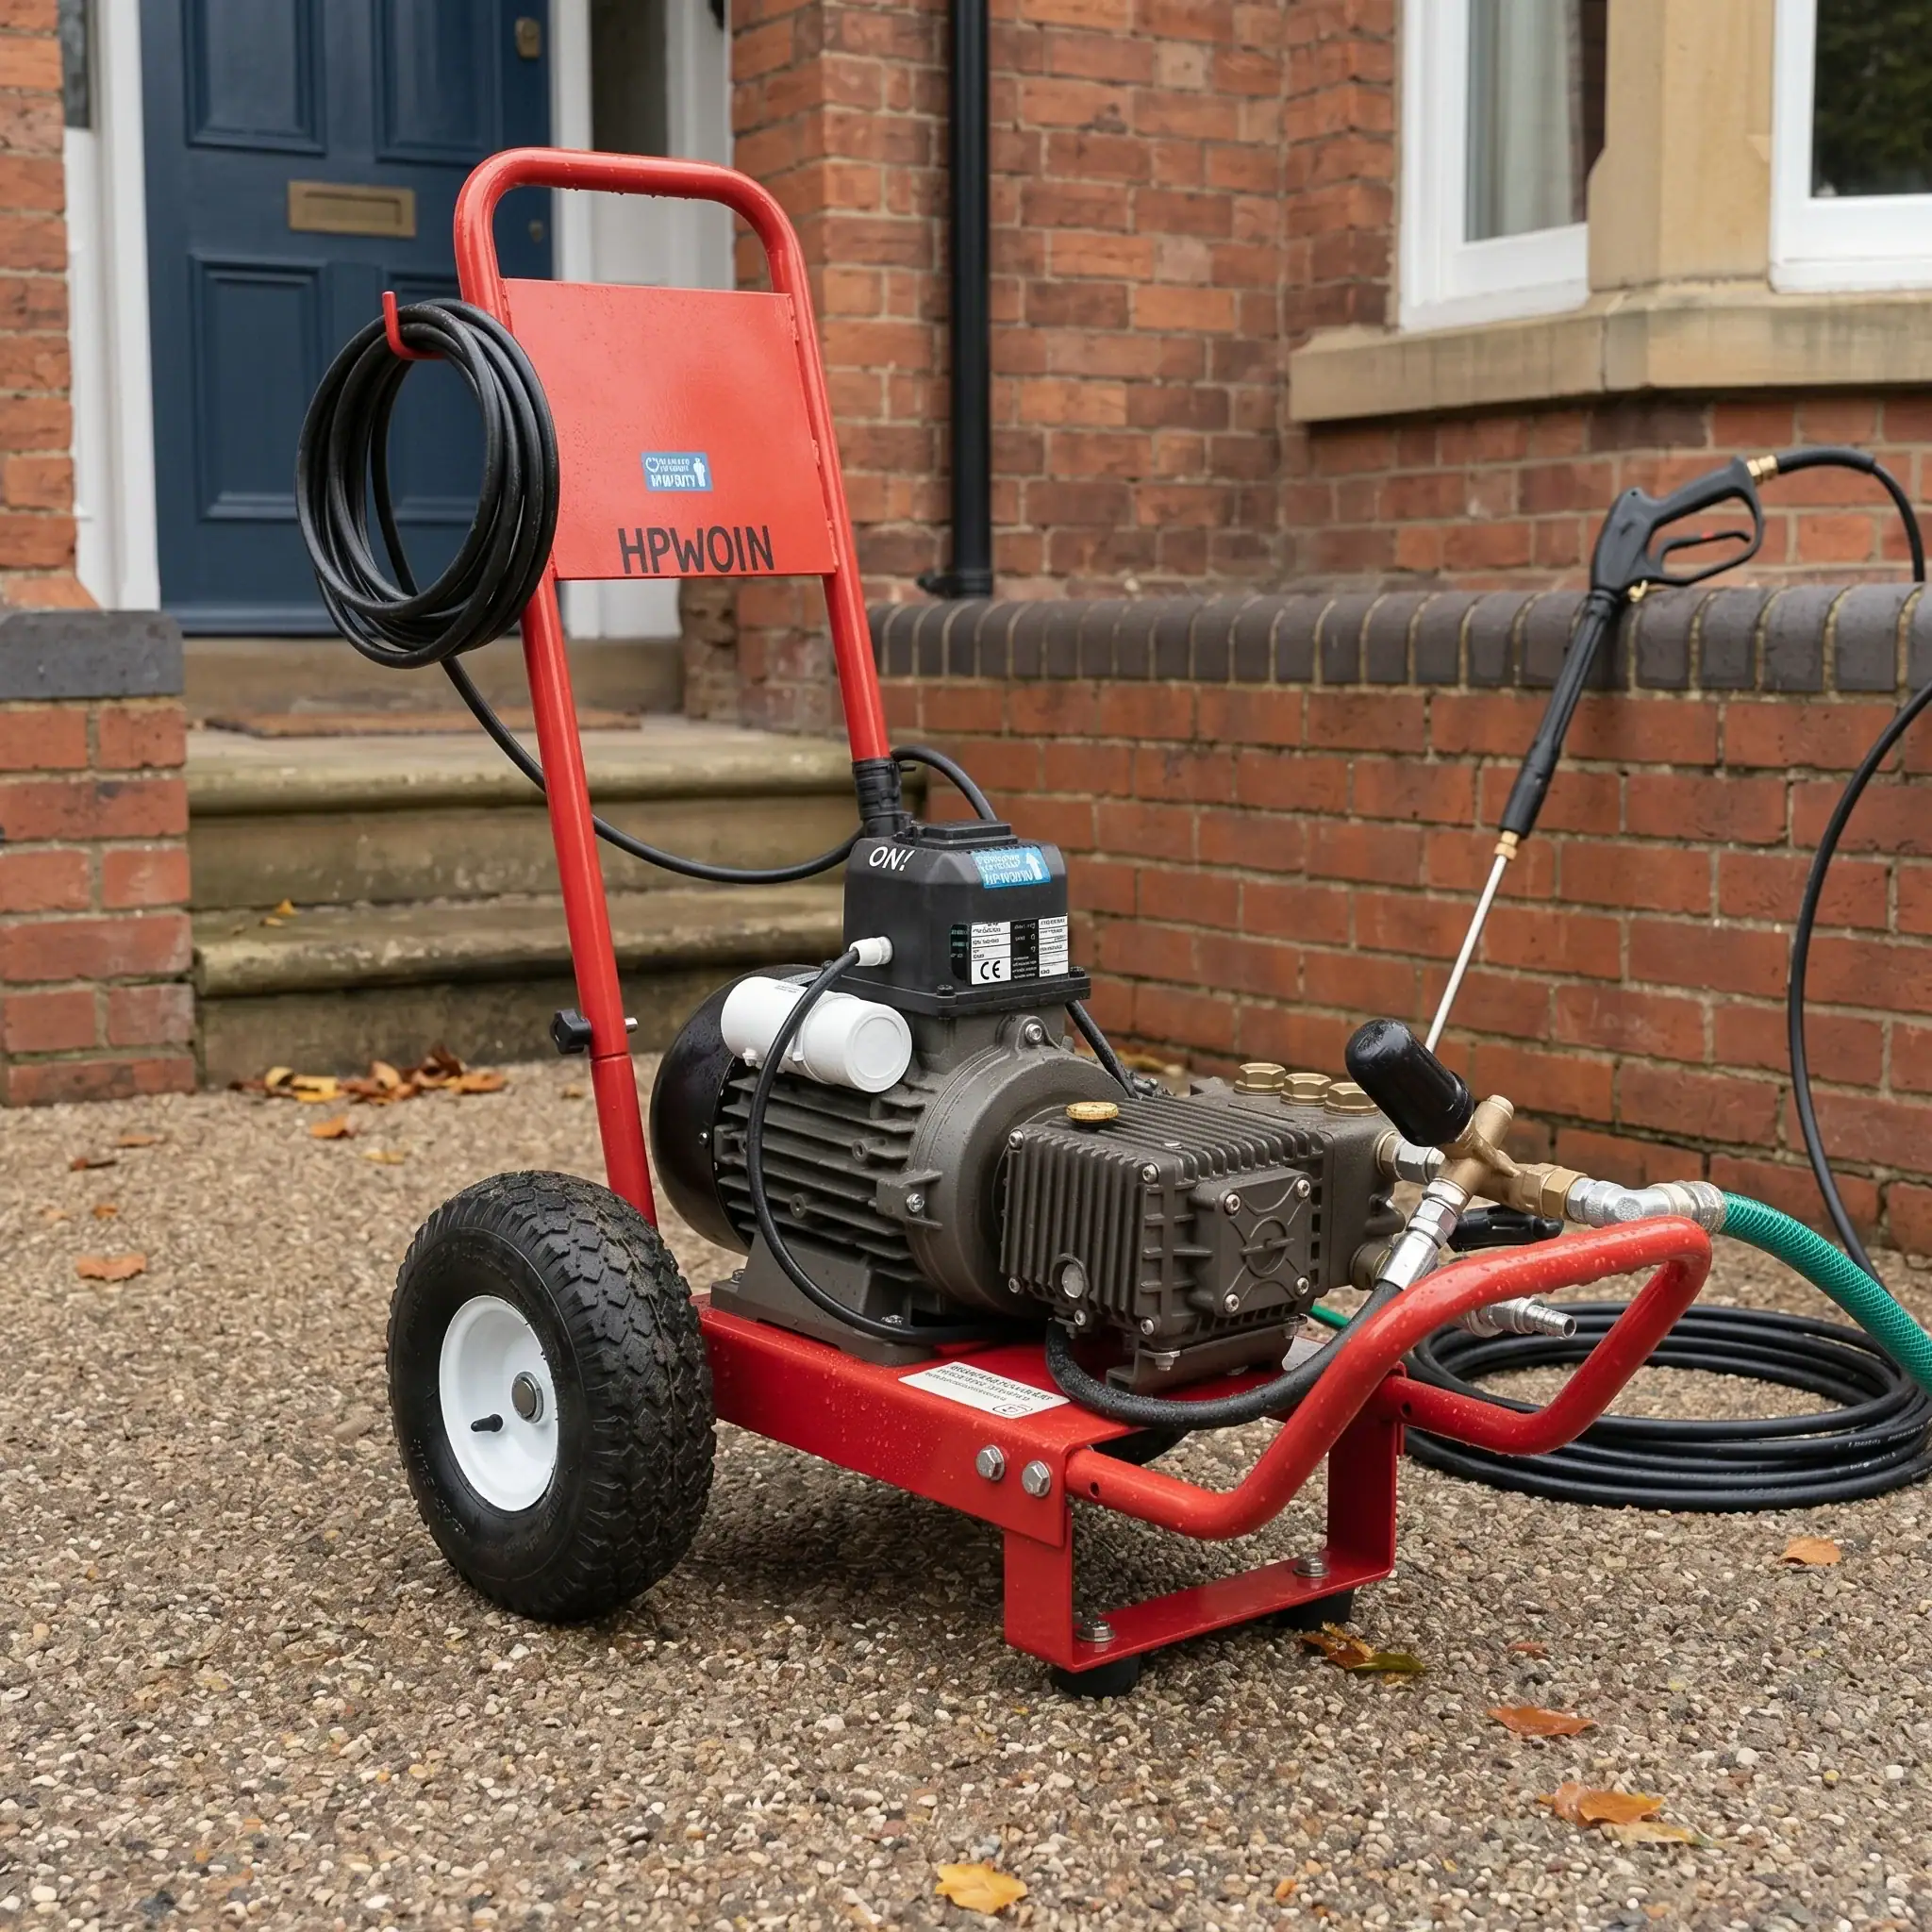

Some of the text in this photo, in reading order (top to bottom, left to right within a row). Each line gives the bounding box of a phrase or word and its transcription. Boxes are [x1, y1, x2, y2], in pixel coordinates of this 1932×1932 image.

[618, 525, 774, 575] HPWOIN
[869, 846, 916, 872] ON!
[980, 960, 1001, 980] CE
